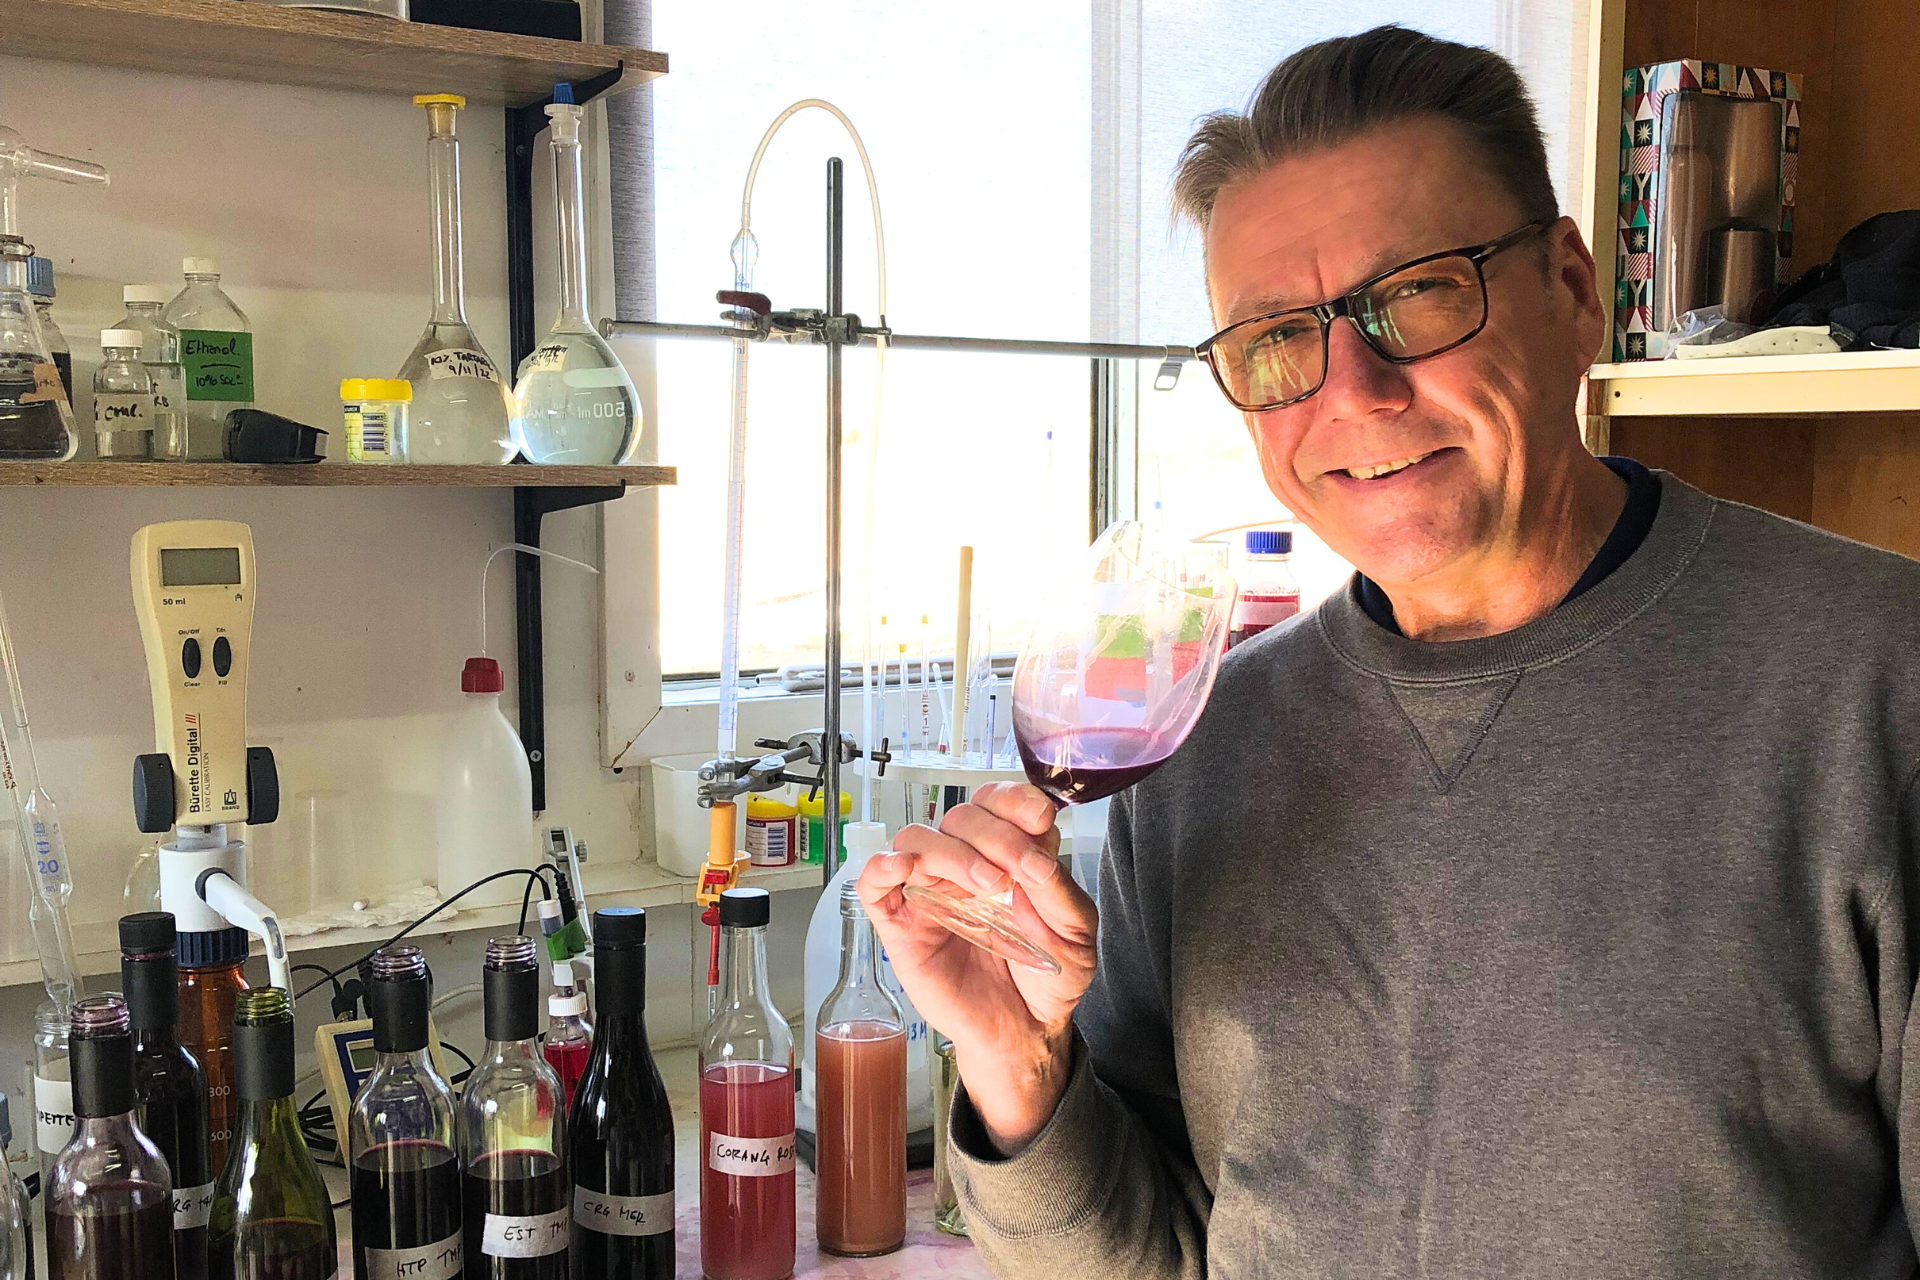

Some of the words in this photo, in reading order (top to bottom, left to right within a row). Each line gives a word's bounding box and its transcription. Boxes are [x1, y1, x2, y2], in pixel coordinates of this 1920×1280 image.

[162, 598, 173, 606] 50
[175, 597, 186, 605] ml
[178, 628, 200, 636] On/Off
[186, 728, 201, 766] Digital
[202, 752, 211, 796] CALIBRATION
[189, 769, 201, 814] Bürette
[203, 797, 212, 812] EASY
[37, 859, 60, 875] 20
[583, 1201, 610, 1217] CRG
[619, 1206, 646, 1226] MER
[504, 1225, 537, 1241] EST
[397, 1258, 427, 1278] HTP
